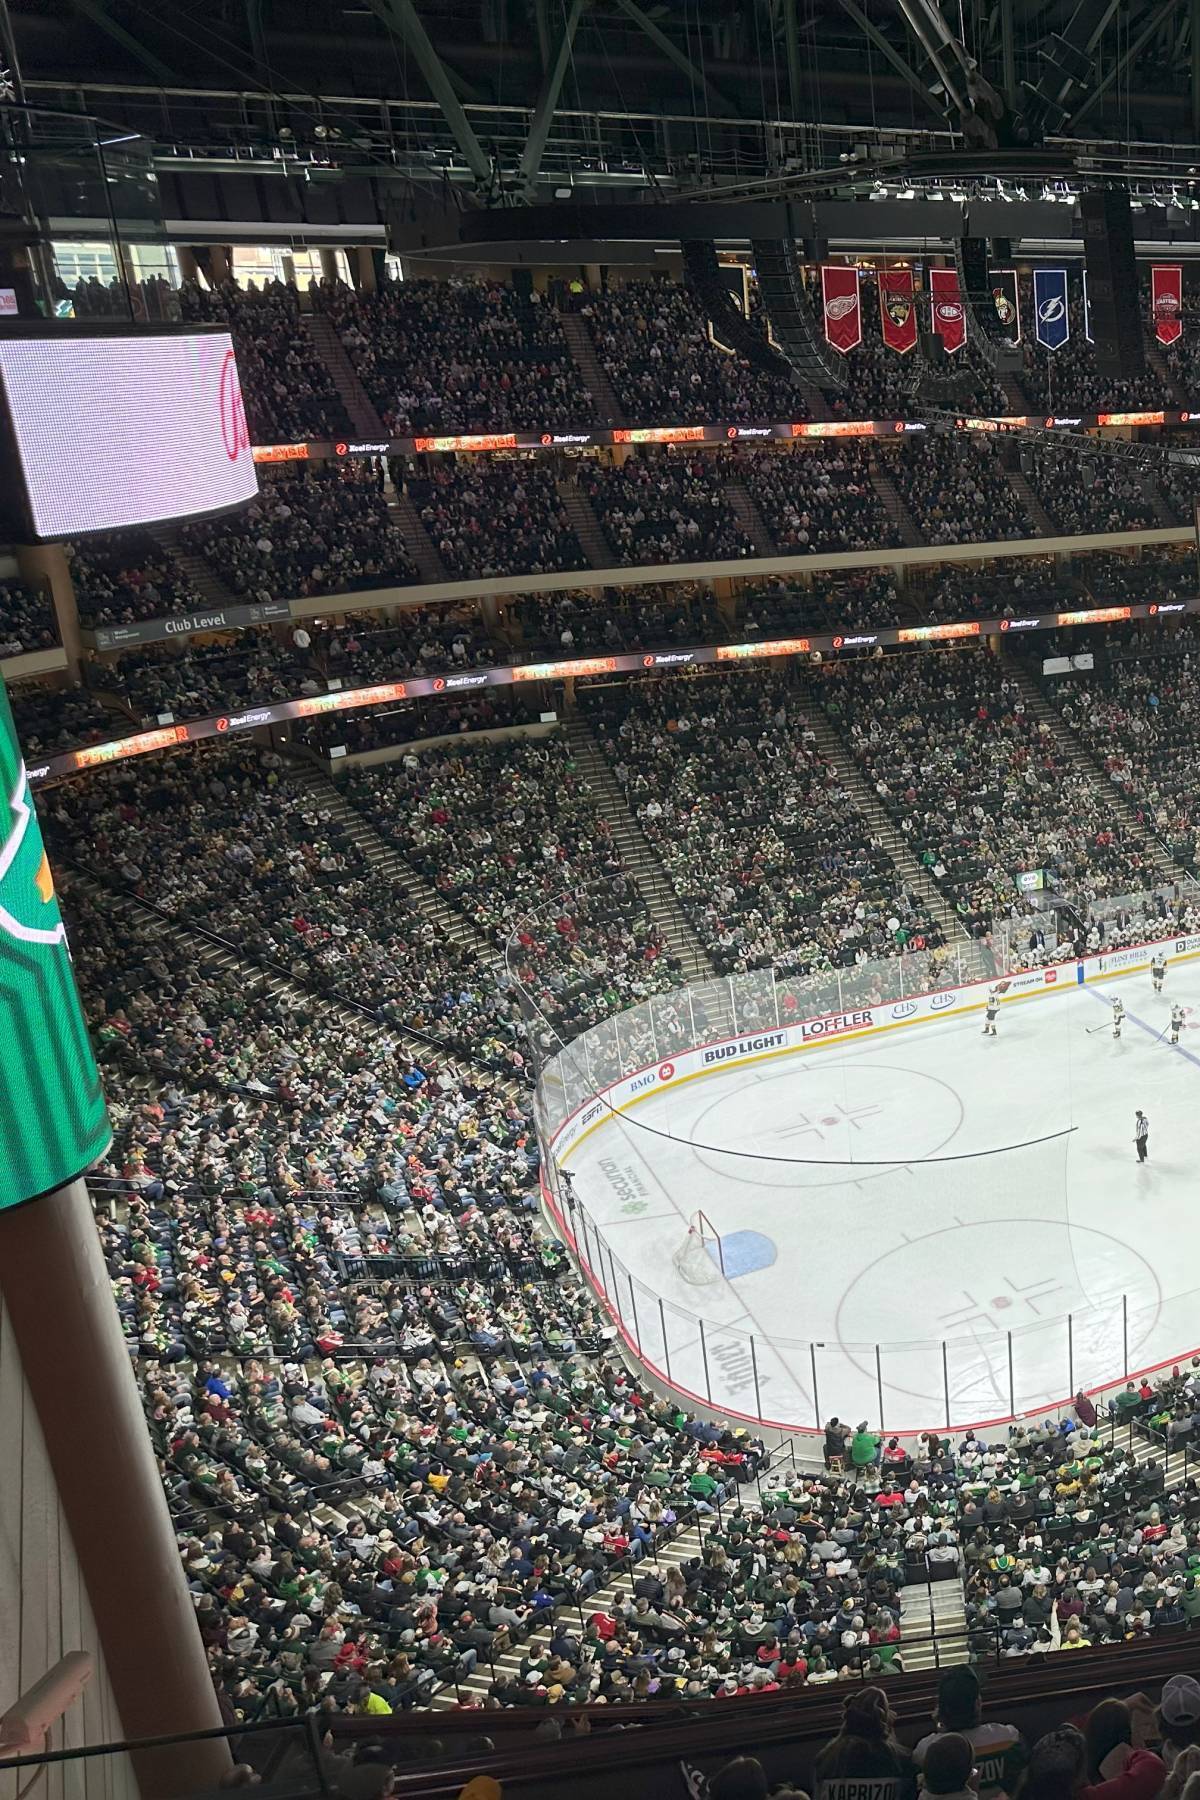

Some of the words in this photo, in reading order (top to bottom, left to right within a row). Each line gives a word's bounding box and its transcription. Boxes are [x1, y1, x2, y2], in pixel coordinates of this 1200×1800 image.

[165, 618, 191, 634] Club
[194, 612, 226, 629] Level
[802, 1011, 873, 1037] LOFFLER
[705, 1045, 737, 1063] BUD
[737, 1033, 784, 1053] LIGHT
[629, 1073, 656, 1092] BMO
[581, 1102, 603, 1126] ESPN
[829, 1782, 897, 1800] KAPRIZO
